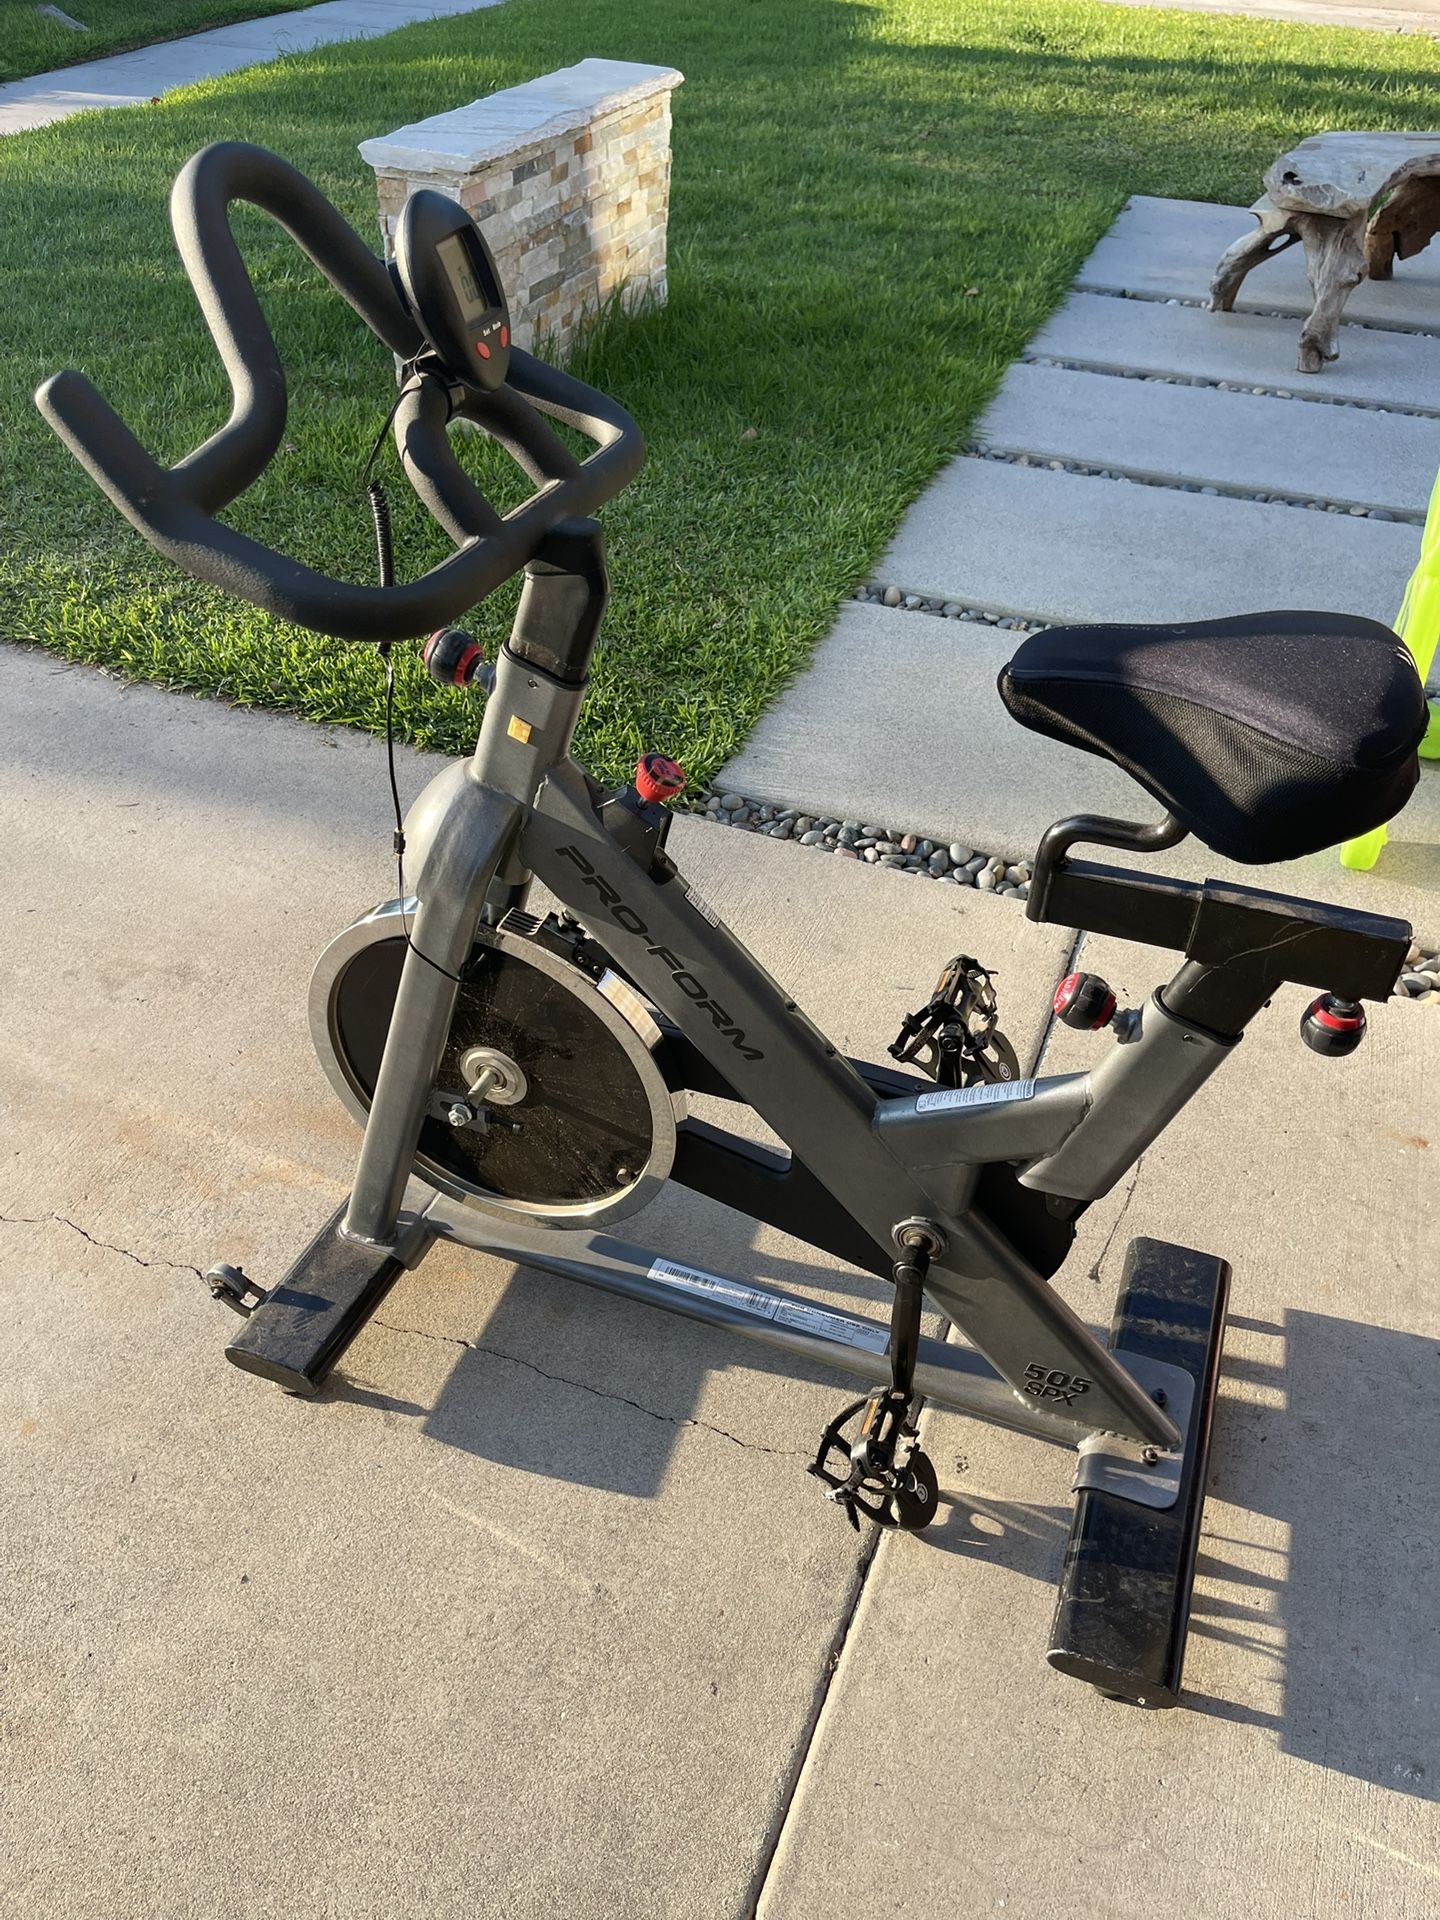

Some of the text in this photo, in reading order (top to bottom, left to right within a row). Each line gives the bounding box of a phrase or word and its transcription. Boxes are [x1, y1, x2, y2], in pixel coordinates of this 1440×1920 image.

[555, 846, 764, 1060] PRO-FORM
[1023, 1361, 1093, 1393] 505
[1023, 1379, 1078, 1406] SPX
